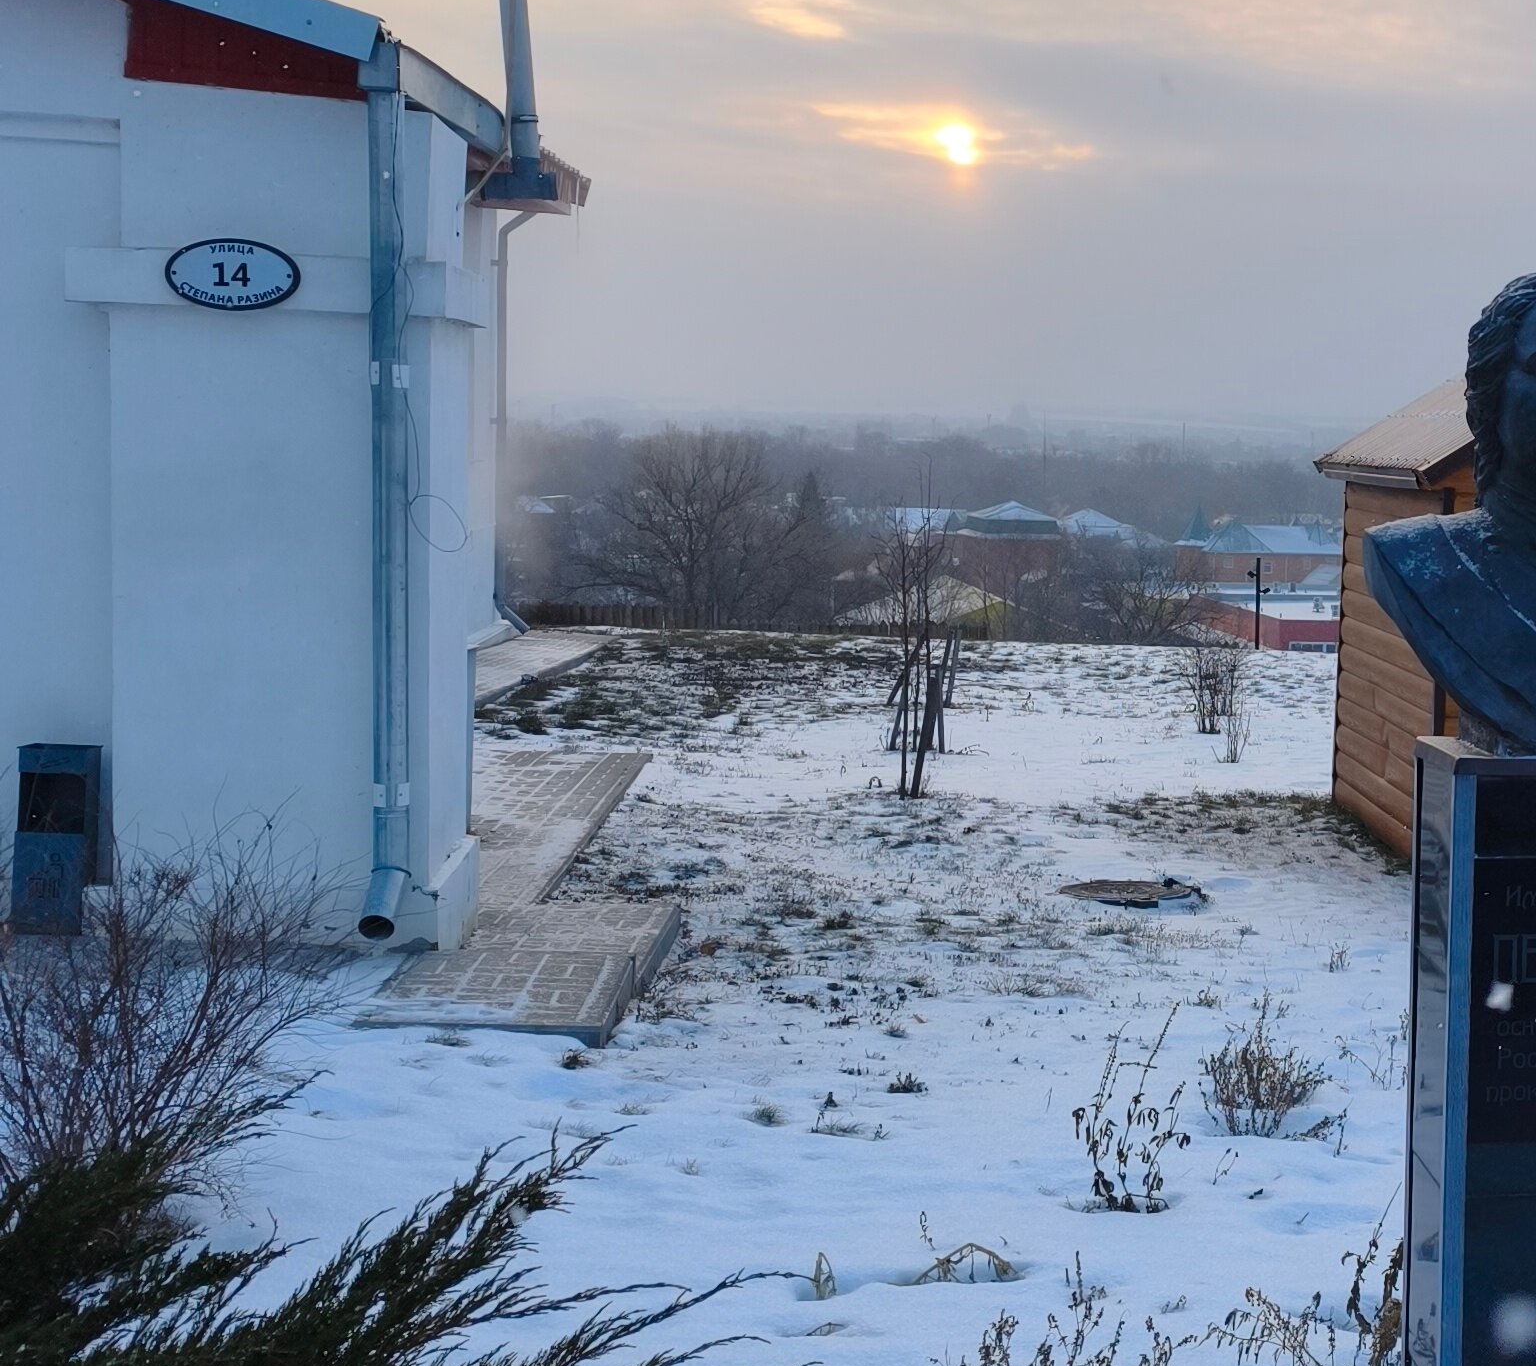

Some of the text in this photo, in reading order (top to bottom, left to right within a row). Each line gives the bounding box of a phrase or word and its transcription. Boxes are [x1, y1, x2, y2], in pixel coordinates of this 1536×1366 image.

[209, 244, 255, 256] УЛИЦА
[212, 262, 251, 288] 14
[180, 281, 285, 305] СТЕПАНА РАЗИНА
